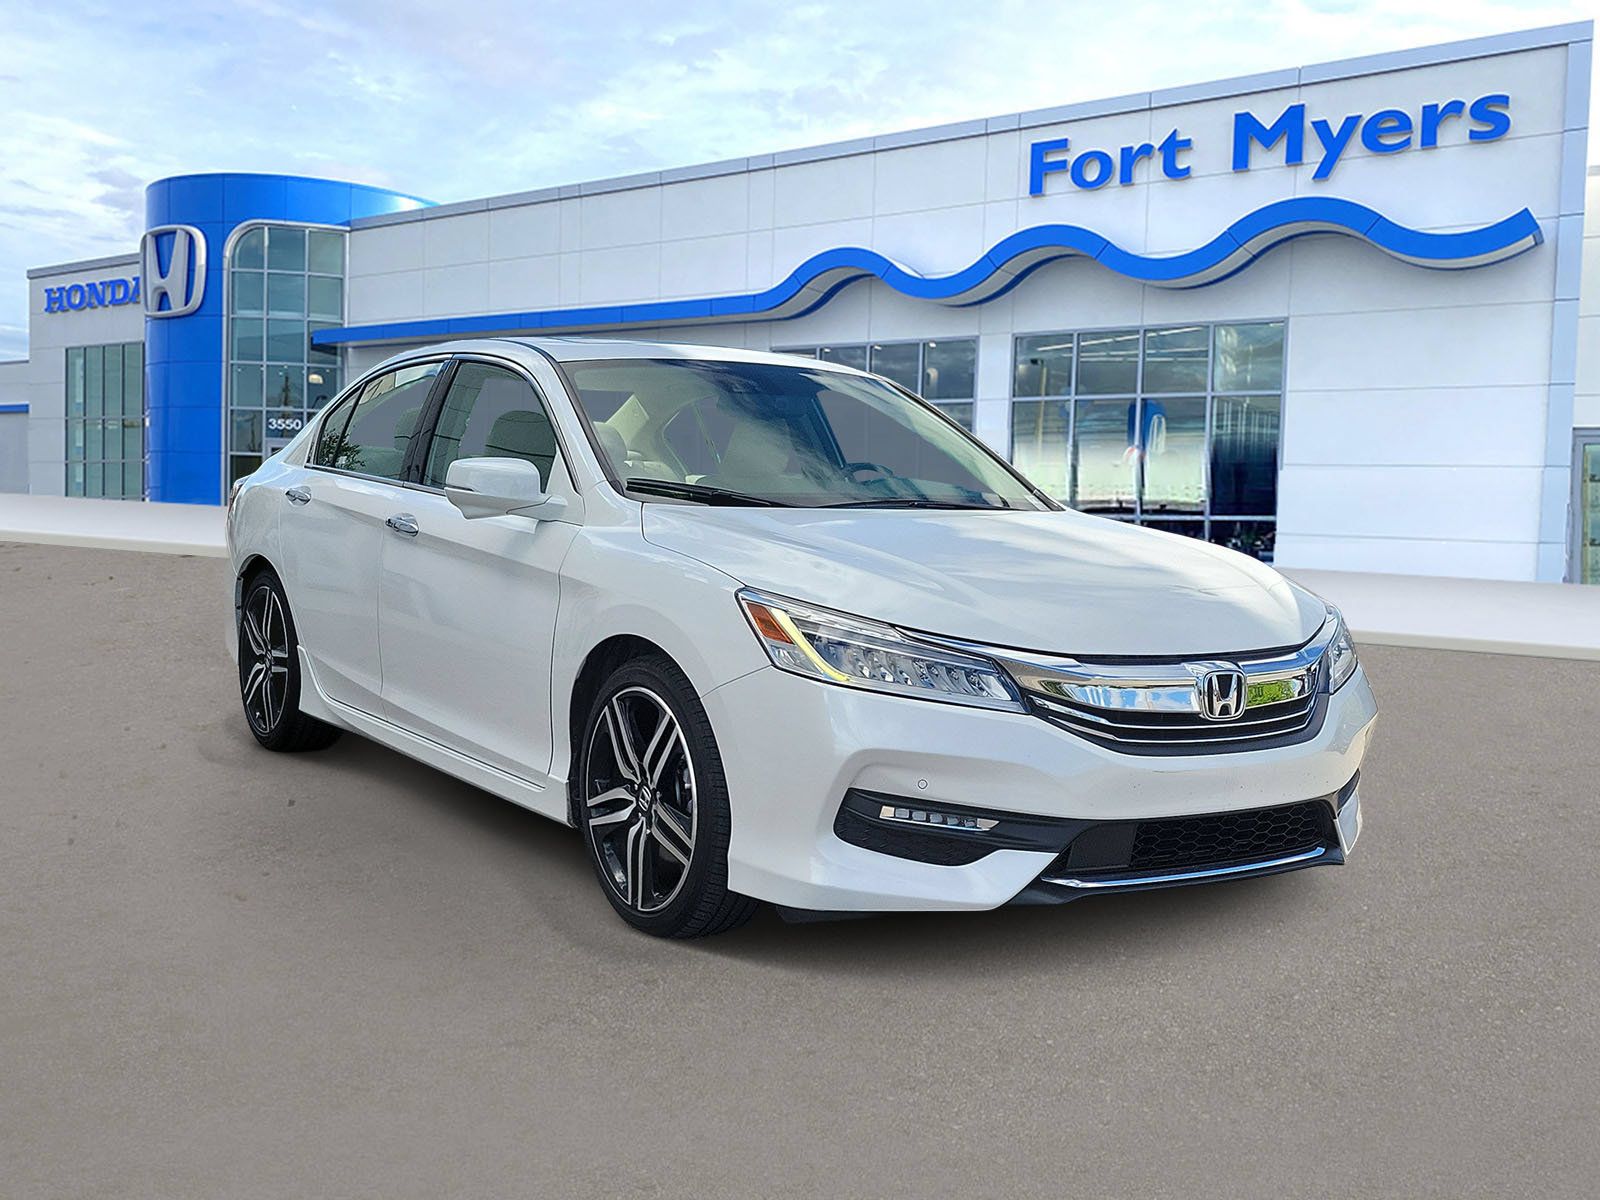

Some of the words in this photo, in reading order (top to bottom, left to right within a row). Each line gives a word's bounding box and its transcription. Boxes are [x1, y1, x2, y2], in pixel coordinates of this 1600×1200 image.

[1029, 128, 1193, 197] Fort
[1232, 94, 1511, 181] Myers
[268, 418, 302, 430] 3550
